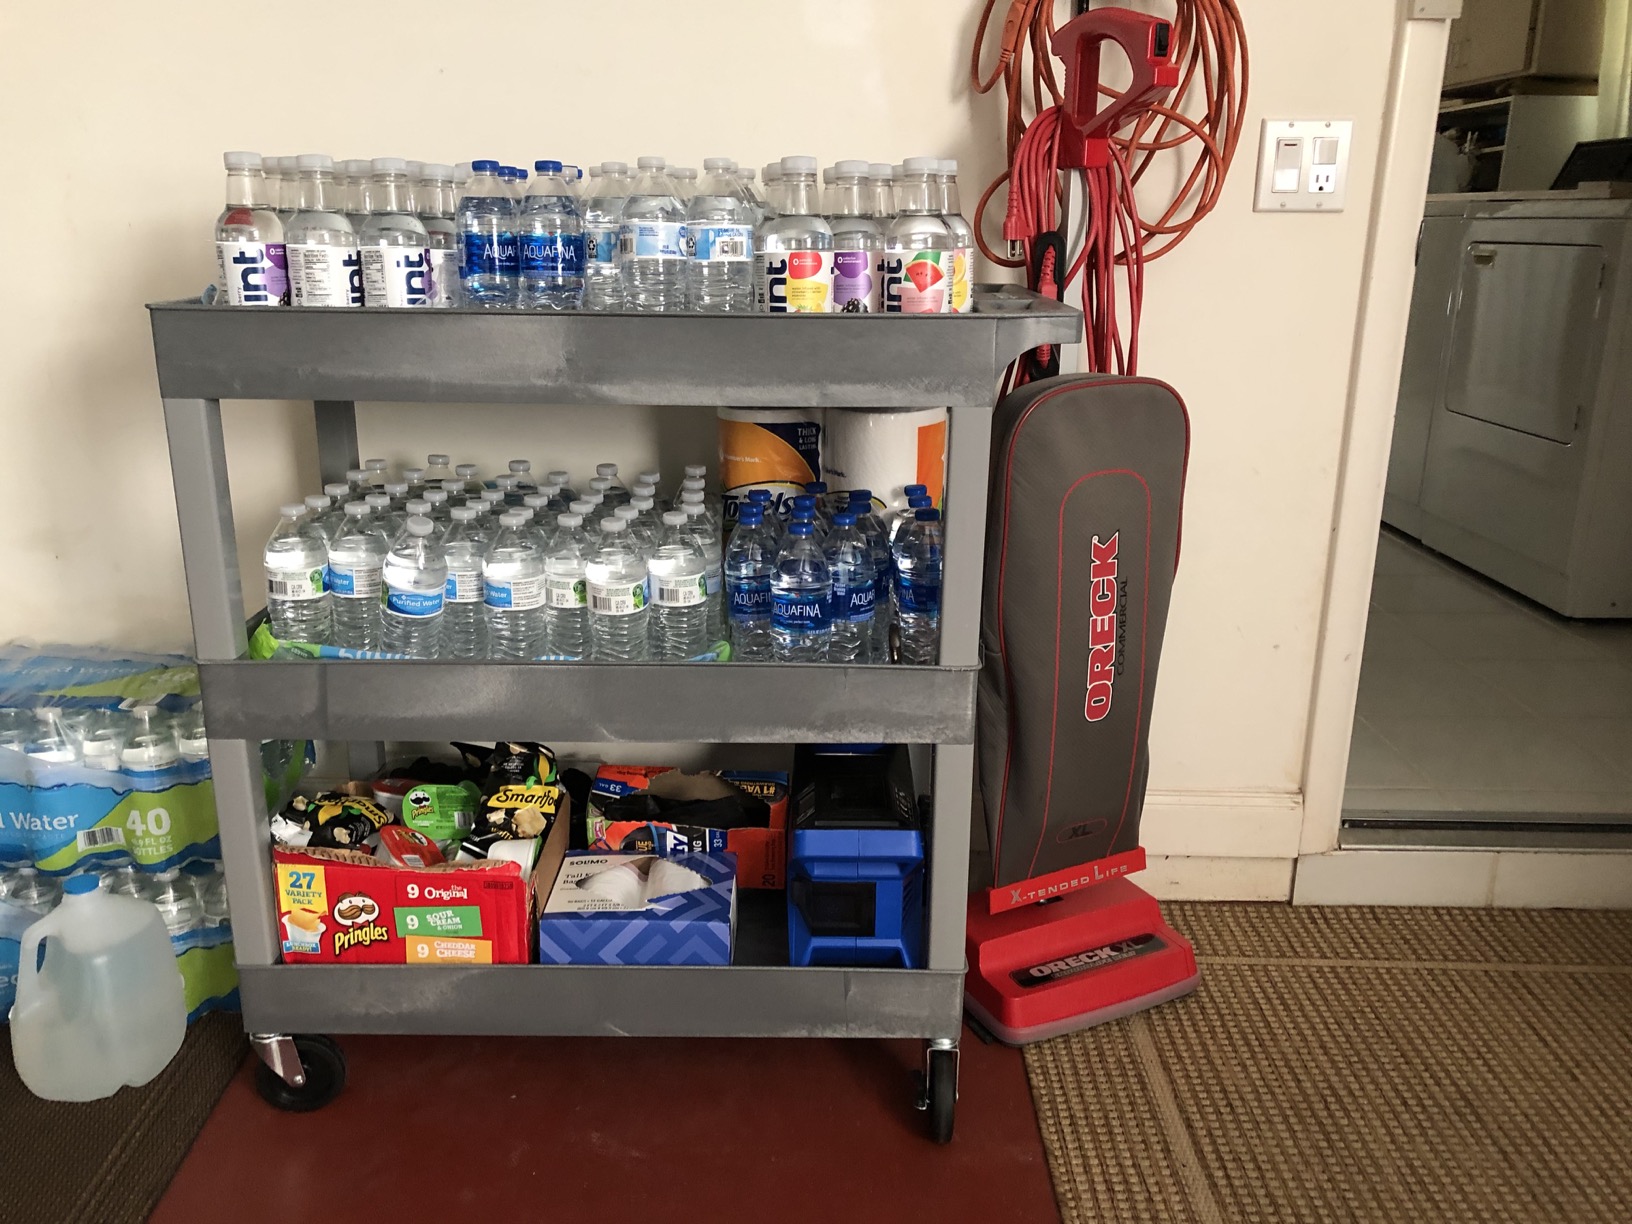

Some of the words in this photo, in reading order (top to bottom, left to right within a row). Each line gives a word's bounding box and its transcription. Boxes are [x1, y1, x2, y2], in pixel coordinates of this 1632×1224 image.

[523, 243, 577, 262] AQUAFINA
[232, 248, 268, 303] int
[396, 252, 427, 306] int
[766, 258, 788, 313] int
[886, 258, 903, 313] int
[797, 427, 816, 436] THICK
[392, 595, 421, 607] Purified
[422, 599, 440, 607] Water
[733, 591, 771, 607] AQUAFI
[772, 601, 823, 618] AQUAFINA
[1084, 531, 1120, 722] ORECK
[1116, 575, 1128, 677] COMMERCIAL
[496, 788, 557, 809] Smartfo
[9, 811, 79, 831] Water
[126, 808, 172, 836] 40
[1068, 824, 1094, 840] XL
[288, 871, 316, 890] 27
[1010, 875, 1090, 905] X-TENDED
[285, 889, 322, 898] VARIETY
[406, 884, 420, 899] 9
[424, 887, 468, 900] Original
[406, 915, 419, 929] 9
[426, 910, 454, 922] SOUR
[430, 917, 462, 926] CREAM
[334, 922, 388, 956] Pringles
[416, 944, 429, 958] 9
[434, 940, 476, 950] CHEDDAR
[436, 949, 476, 958] CHEESE
[1029, 946, 1120, 977] ORECK
[1116, 941, 1144, 953] XL
